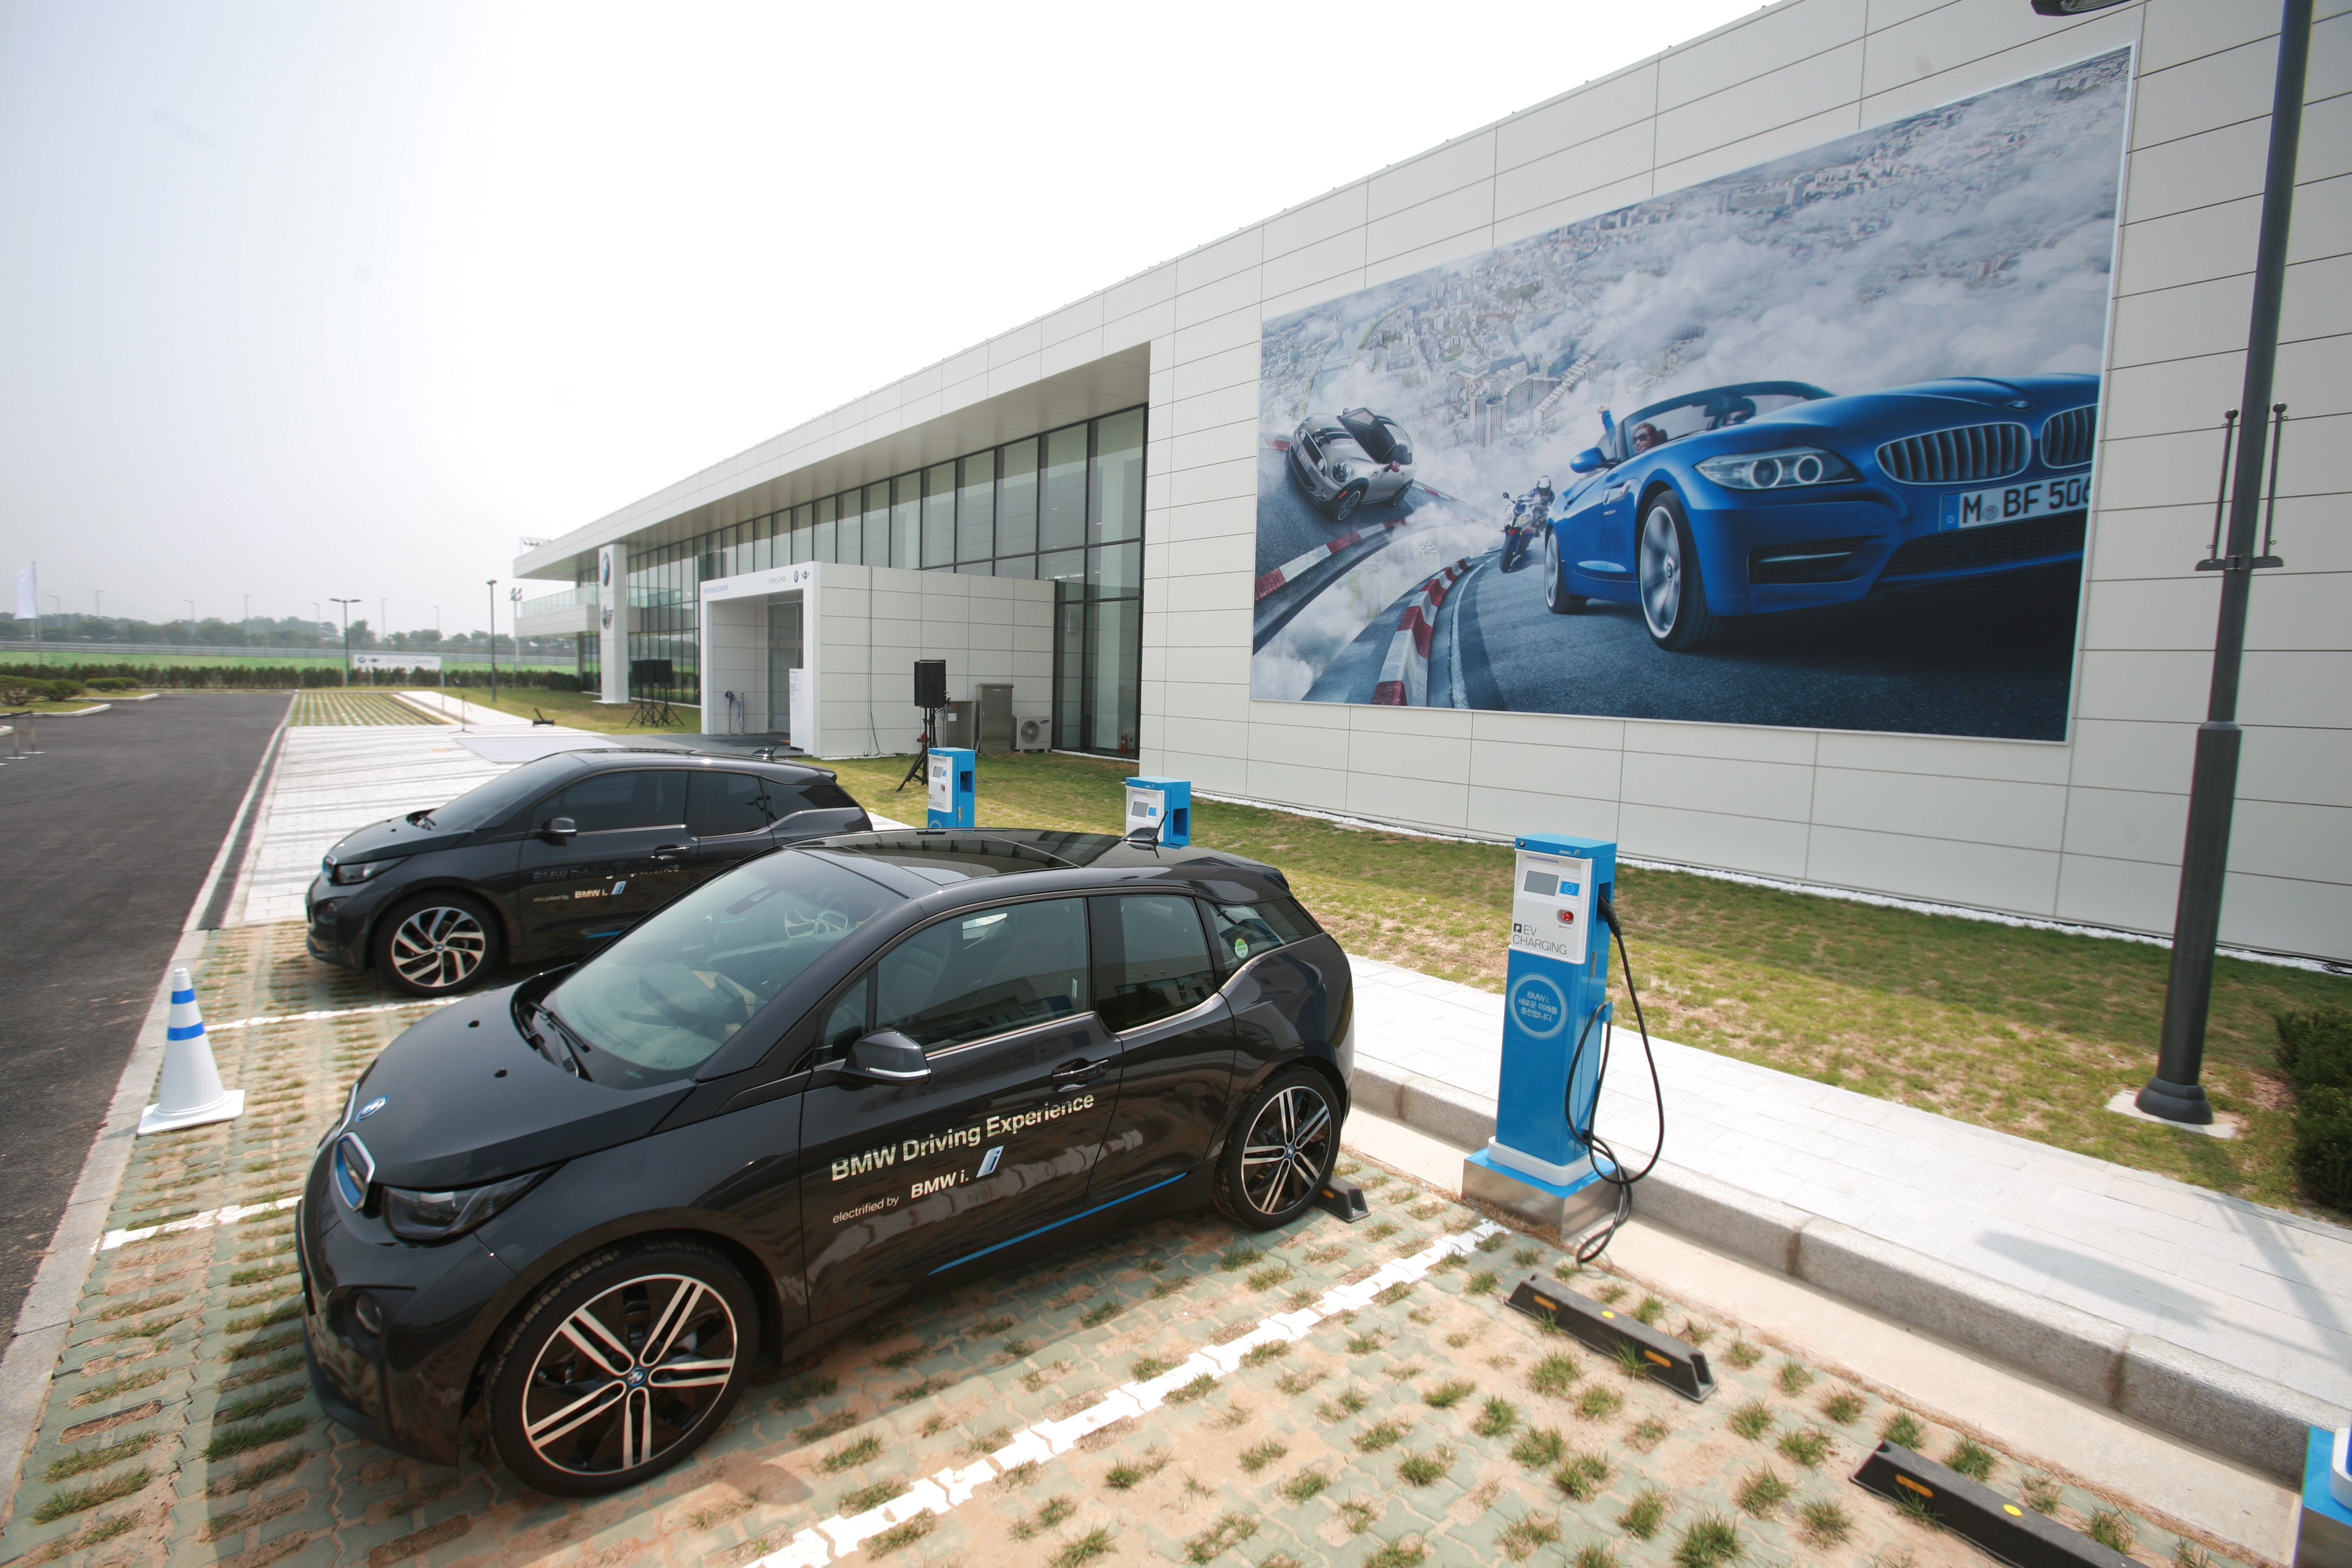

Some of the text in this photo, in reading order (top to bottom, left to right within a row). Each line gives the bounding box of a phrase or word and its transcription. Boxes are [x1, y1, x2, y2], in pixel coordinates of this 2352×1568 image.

[1962, 494, 1982, 524] M
[2004, 485, 2041, 518] BF
[387, 657, 411, 666] Driving
[574, 890, 600, 899] BMW
[1523, 925, 1537, 936] EV
[1513, 934, 1567, 955] CHARGING
[1527, 991, 1545, 1002] BMW
[1517, 997, 1558, 1015] 새로운 미래를
[1520, 1006, 1553, 1023] 충전합니다.
[831, 1093, 1094, 1181] BMW Driving Experience
[832, 1198, 884, 1224] electrified
[886, 1196, 900, 1207] by
[911, 1171, 957, 1199] BMW
